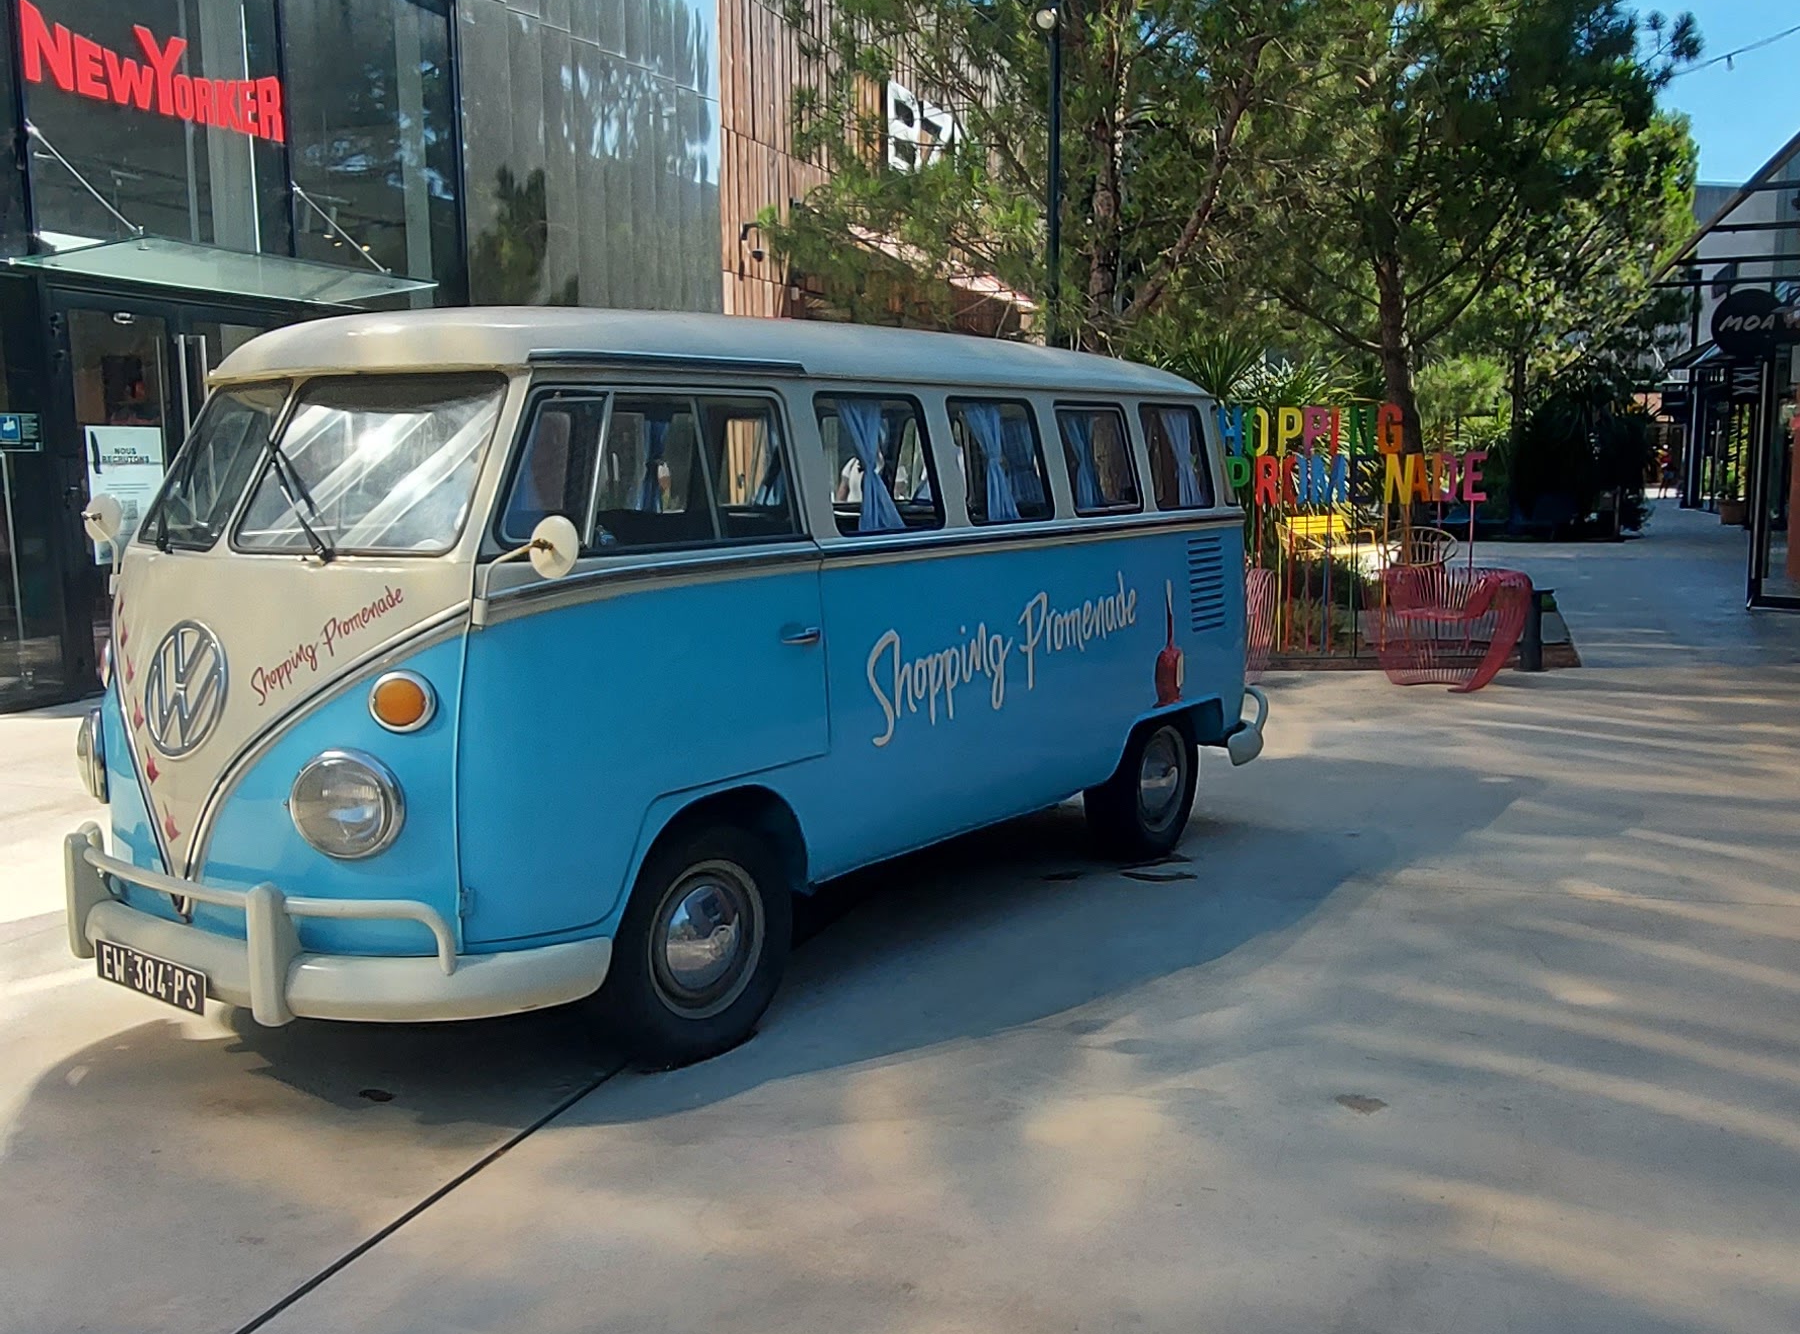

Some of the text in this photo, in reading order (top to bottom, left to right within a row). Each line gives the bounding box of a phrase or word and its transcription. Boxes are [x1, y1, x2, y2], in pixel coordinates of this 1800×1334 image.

[1718, 314, 1775, 332] MOA
[114, 447, 137, 455] NOUS
[1217, 403, 1404, 459] HOPPING
[1226, 451, 1488, 505] PROMENADE
[250, 585, 404, 707] Shopping Promenade
[867, 570, 1137, 747] Shopping Promenade
